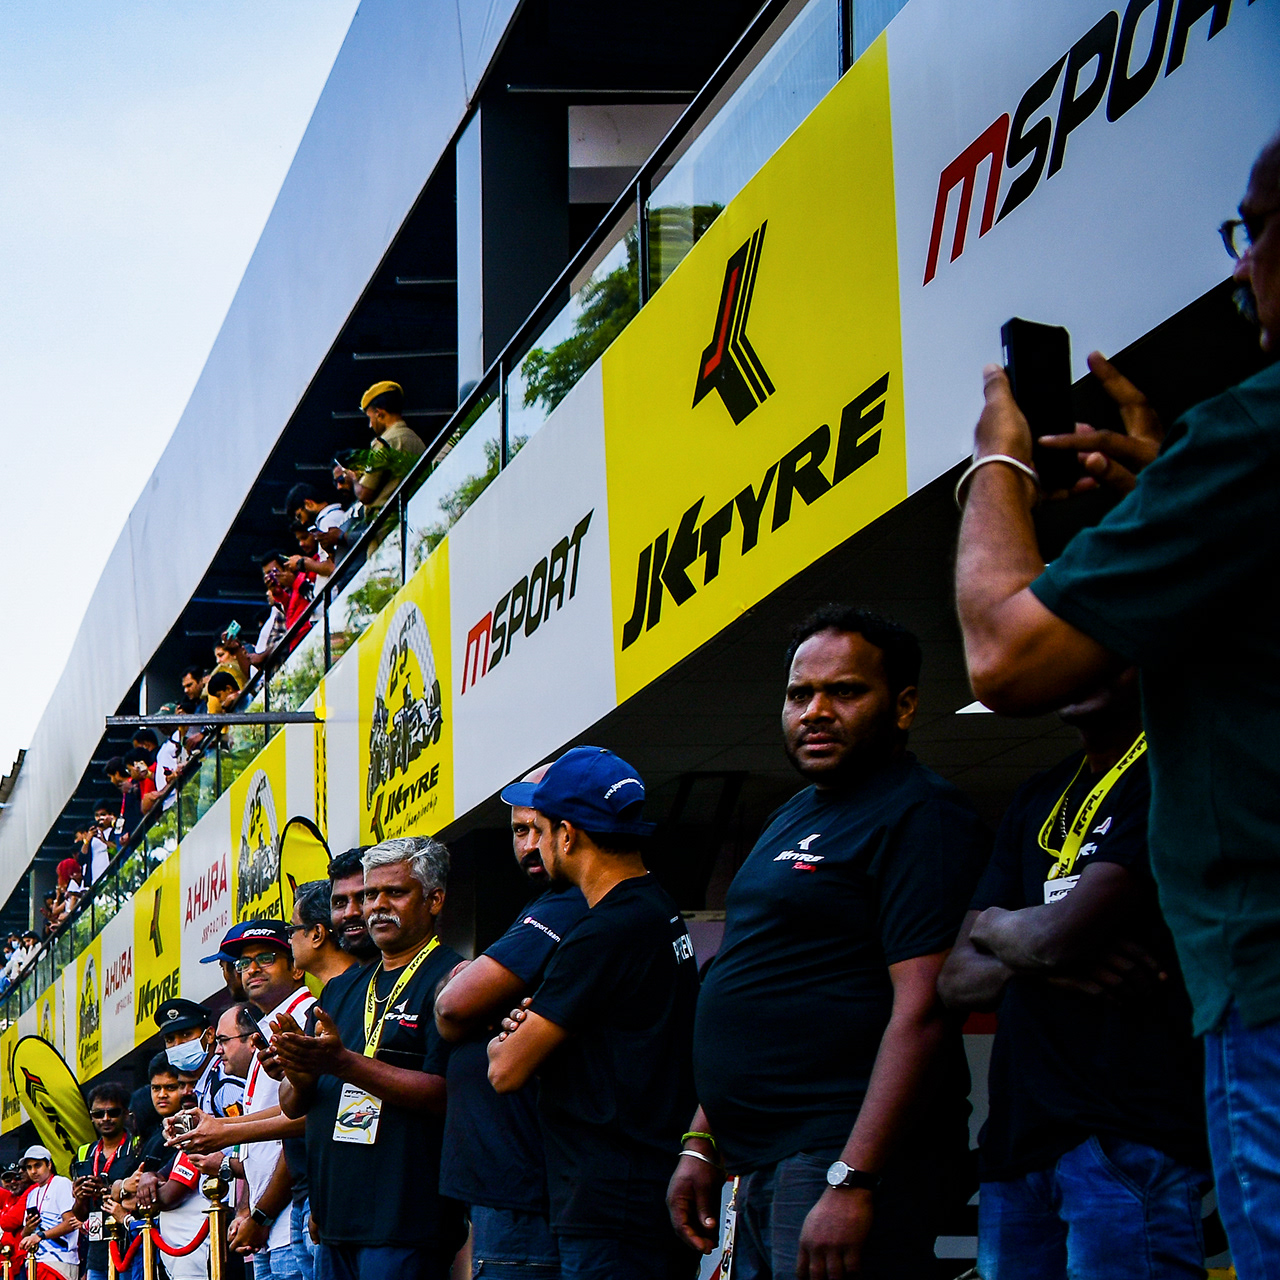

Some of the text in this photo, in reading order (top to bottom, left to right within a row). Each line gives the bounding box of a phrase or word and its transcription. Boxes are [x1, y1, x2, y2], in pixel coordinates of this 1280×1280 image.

[461, 508, 595, 695] MSPORT
[1072, 789, 1105, 837] RPPL
[184, 852, 228, 932] AHURA
[103, 946, 132, 1002] AHURA
